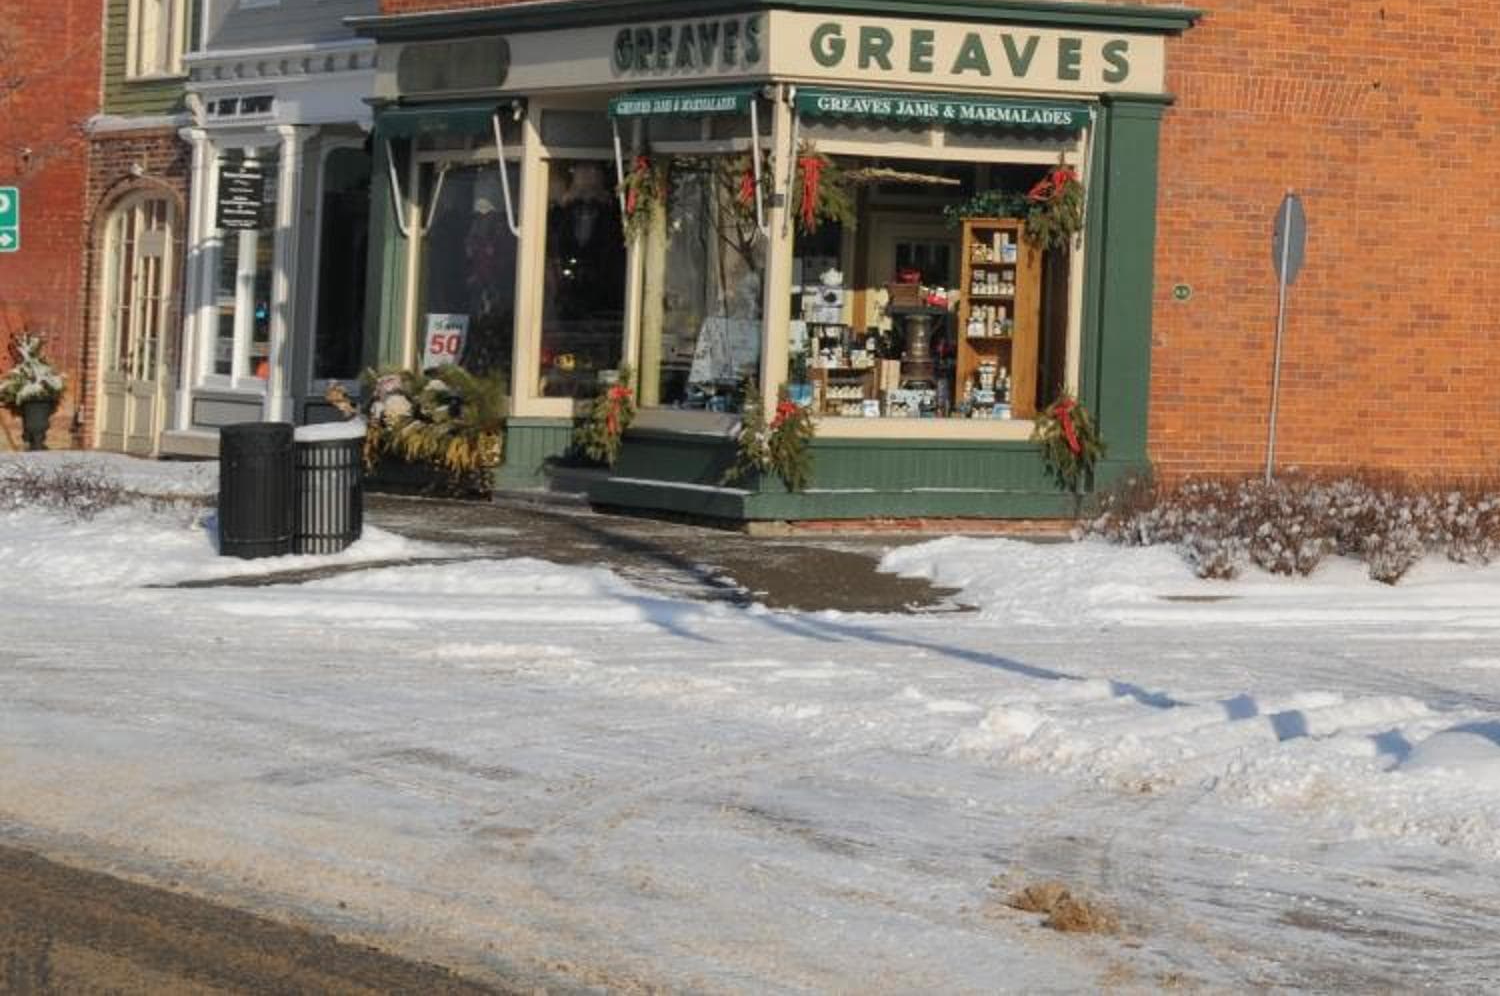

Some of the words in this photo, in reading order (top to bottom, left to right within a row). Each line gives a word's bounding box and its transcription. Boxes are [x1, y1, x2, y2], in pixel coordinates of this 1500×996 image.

[613, 14, 761, 72] GREAVES
[809, 21, 1130, 84] GREAVES
[816, 96, 892, 115] GREAVES
[896, 100, 939, 117] JAMS
[943, 105, 955, 119] &
[960, 105, 1073, 125] MARMALADES
